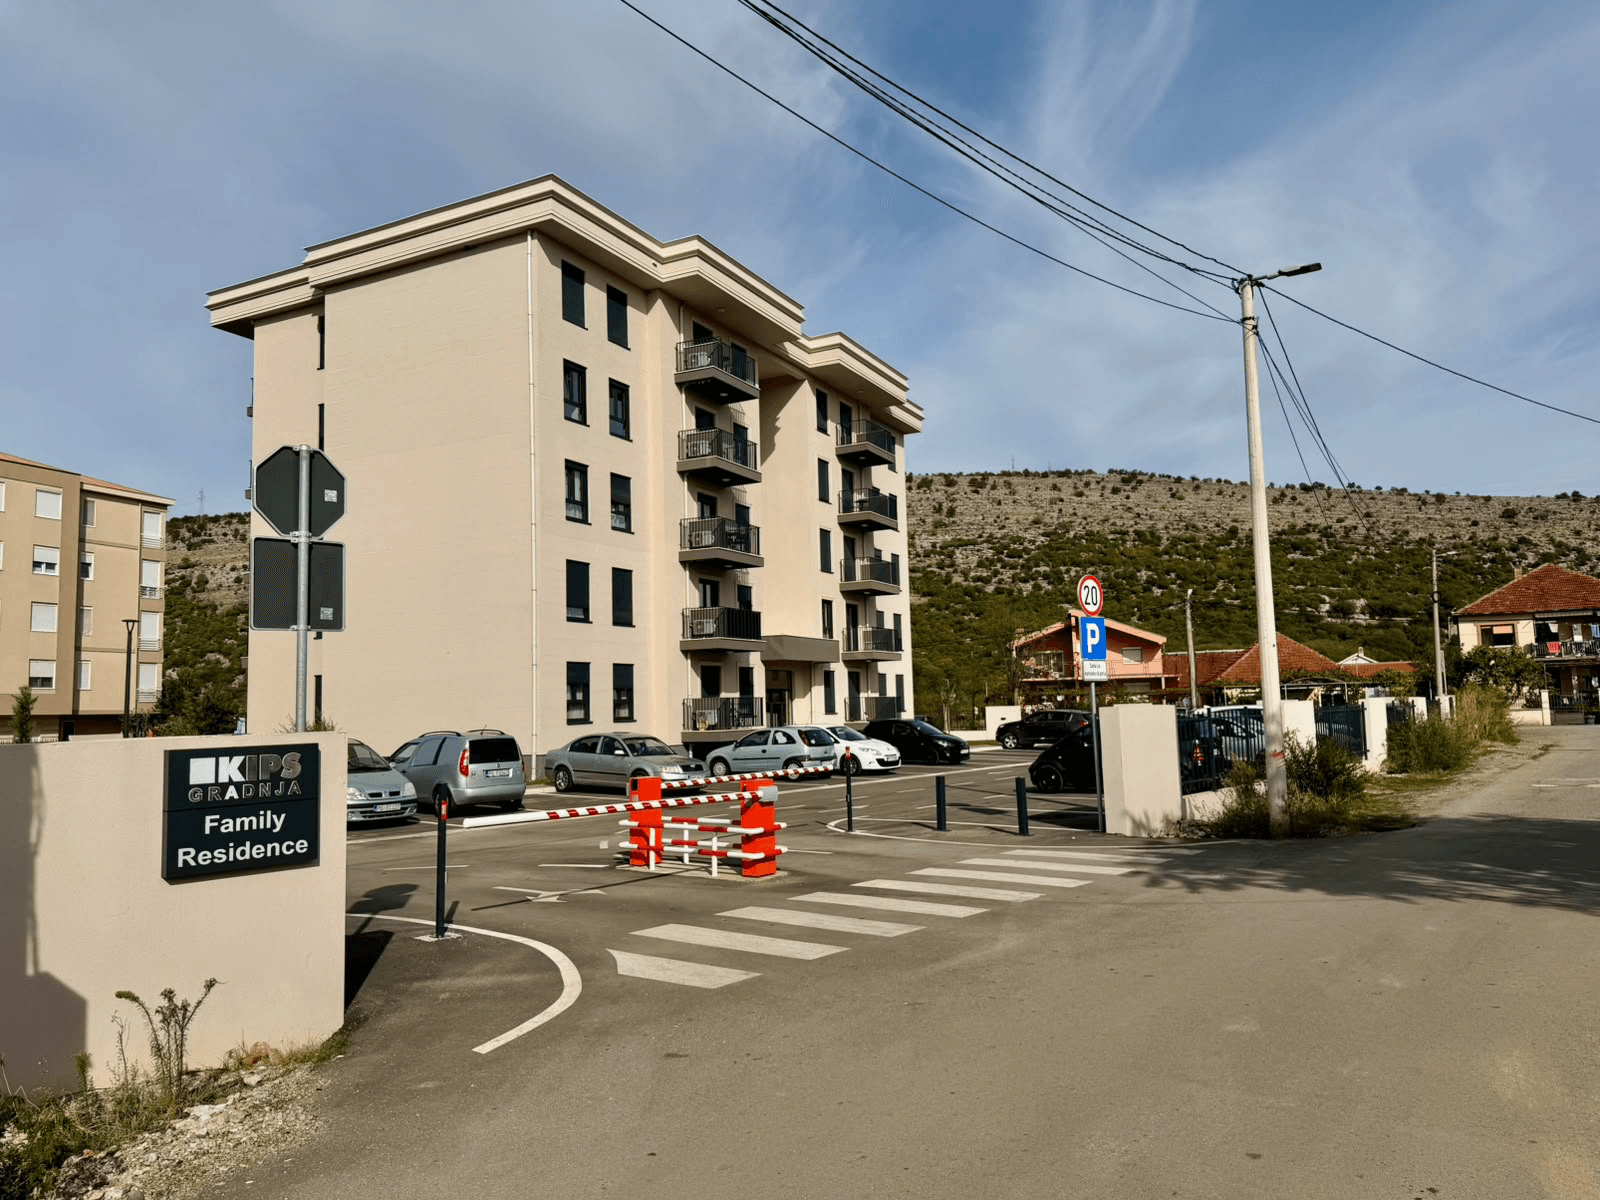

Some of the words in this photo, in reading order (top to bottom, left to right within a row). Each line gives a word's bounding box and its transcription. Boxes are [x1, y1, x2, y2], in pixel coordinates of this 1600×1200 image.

[1084, 585, 1098, 606] 20
[1086, 623, 1100, 653] P
[218, 752, 302, 784] KIPS
[188, 780, 302, 803] GRADNJA
[204, 810, 286, 835] Family
[177, 838, 309, 868] Residence
